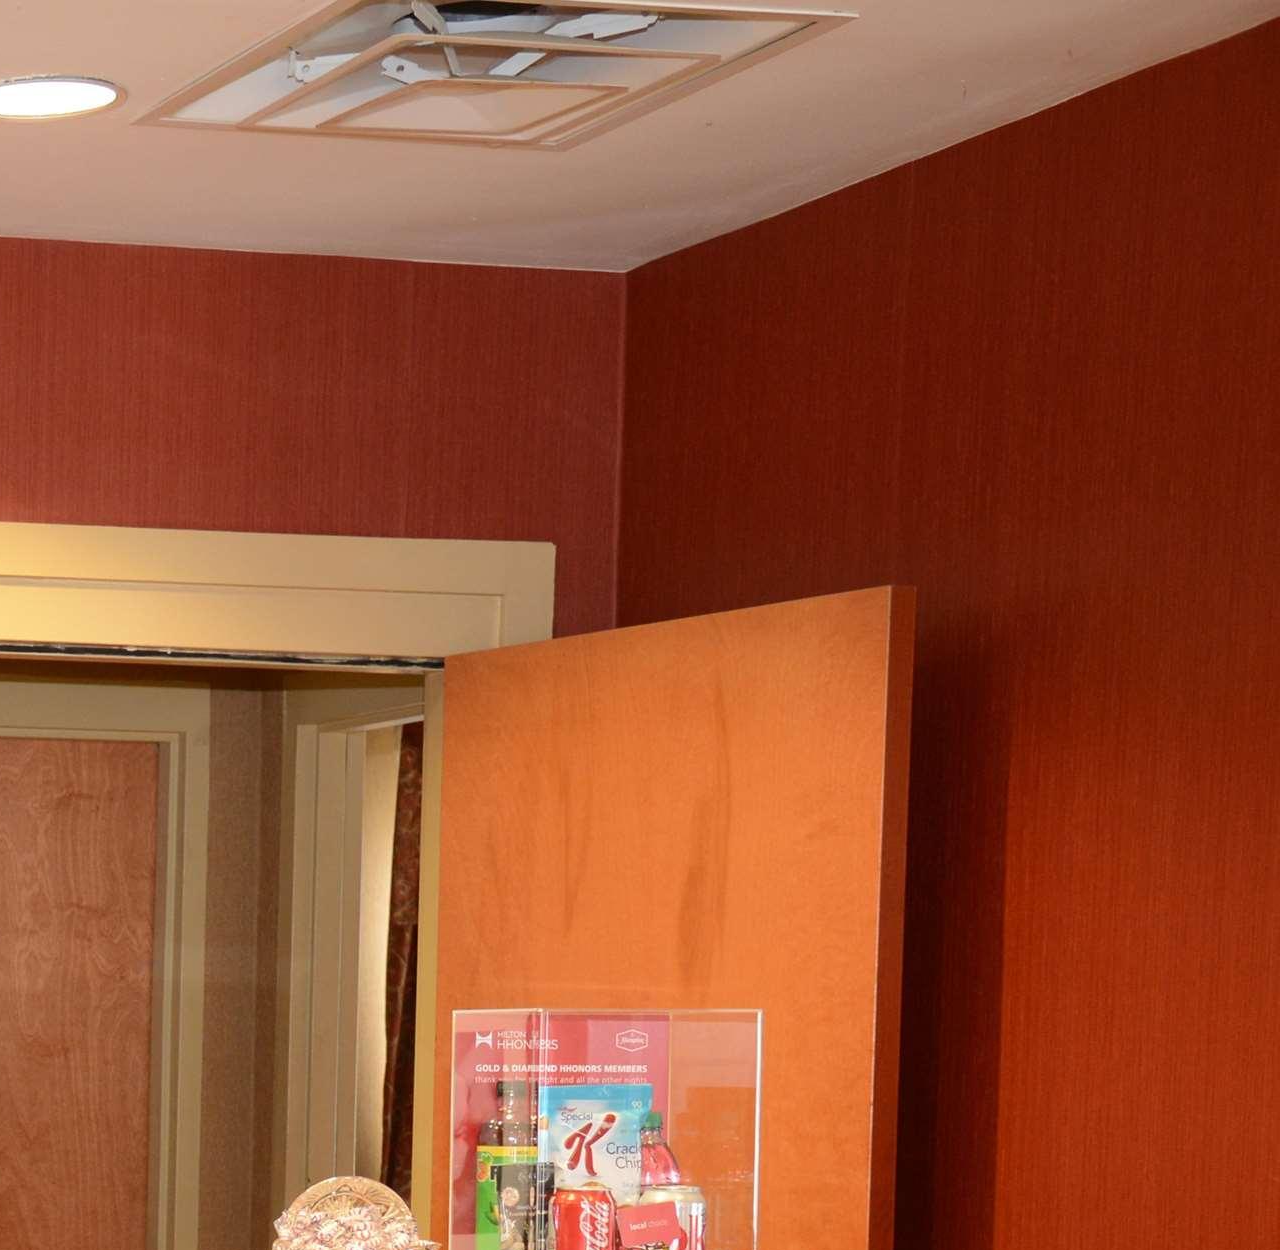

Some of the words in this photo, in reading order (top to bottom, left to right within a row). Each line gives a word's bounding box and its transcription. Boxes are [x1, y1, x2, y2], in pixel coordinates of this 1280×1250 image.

[475, 1064, 499, 1073] GOLD
[559, 1064, 602, 1073] HHONORS
[604, 1064, 648, 1073] MEMBERS
[561, 1111, 593, 1124] Special
[564, 1113, 617, 1177] K
[606, 1142, 639, 1155] Crac
[615, 1156, 641, 1172] Chip
